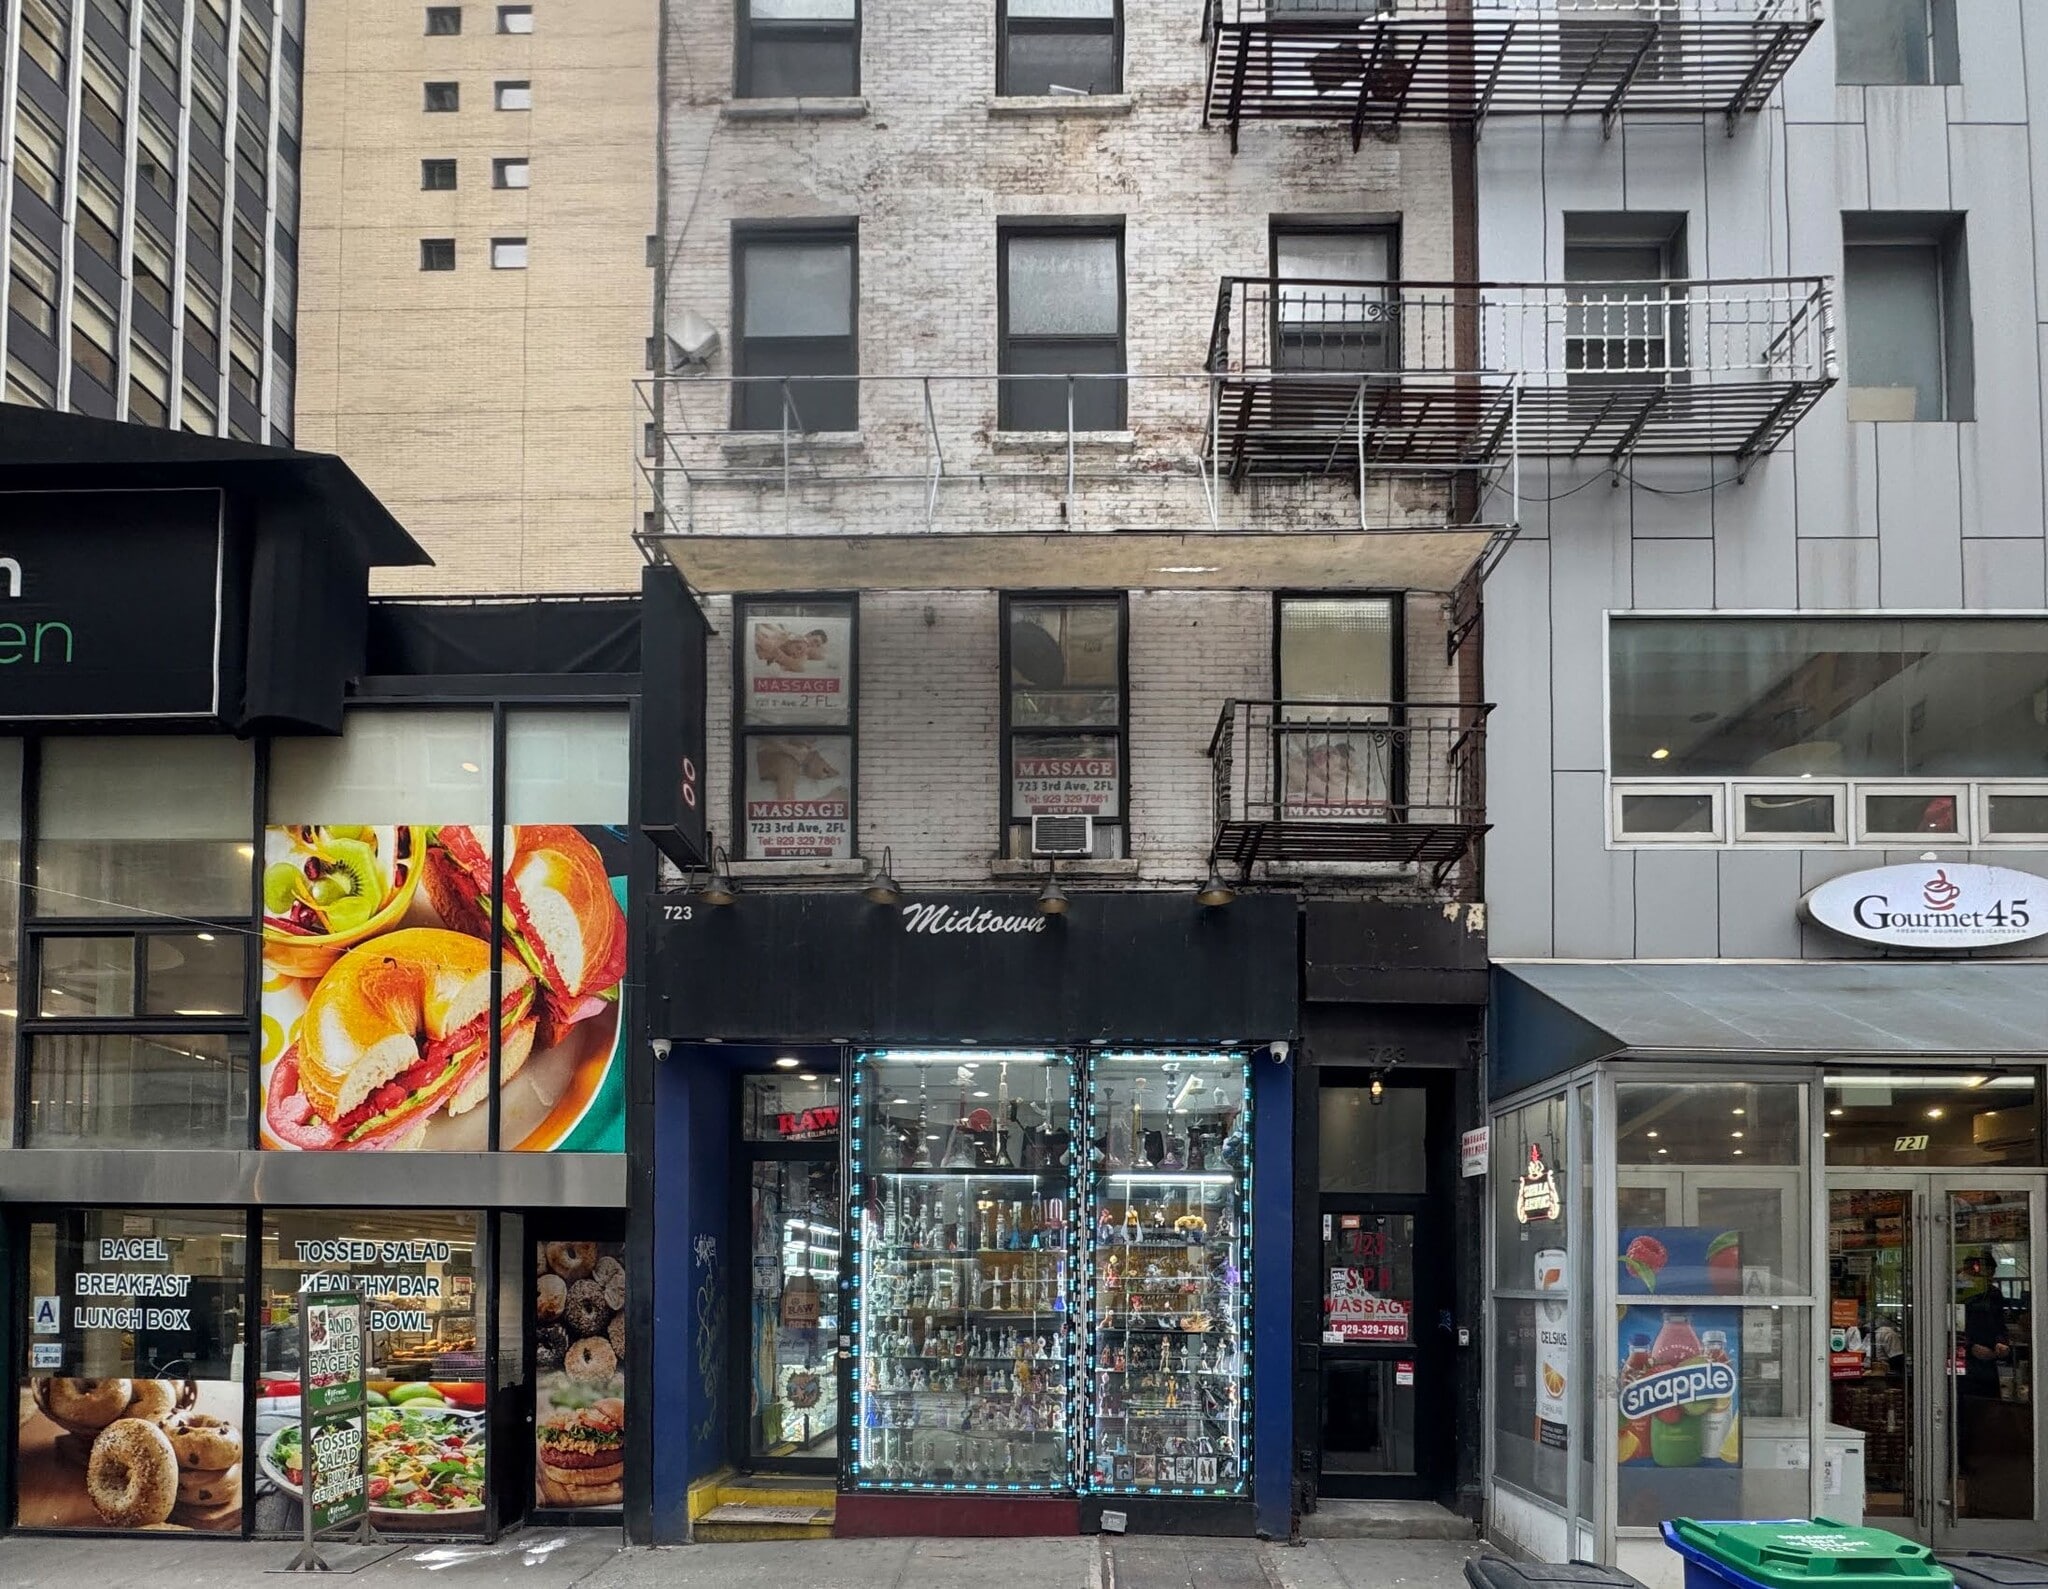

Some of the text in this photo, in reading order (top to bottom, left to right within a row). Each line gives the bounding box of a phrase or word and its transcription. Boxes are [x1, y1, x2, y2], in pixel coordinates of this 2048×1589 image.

[757, 680, 834, 692] MASSAGE
[800, 694, 809, 707] 2
[1019, 762, 1113, 776] MASSAGE
[1018, 781, 1113, 793] 723 3rd Ave, 2FL
[1024, 794, 1040, 804] Tel:
[1043, 794, 1061, 804] 929
[1064, 794, 1082, 804] 329
[752, 803, 844, 817] MASSAGE
[1288, 803, 1384, 816] MASSAGE
[751, 822, 846, 835] 723 3rd Ave, 2FL
[758, 836, 774, 845] Tel:
[776, 836, 794, 845] 929
[797, 836, 815, 845] 329
[663, 906, 692, 920] 723
[902, 903, 1046, 934] Midtown
[777, 1105, 839, 1134] RAW
[1898, 1137, 1924, 1150] 721
[100, 1238, 168, 1261] BAGEL
[296, 1240, 450, 1263] TOSSED SALAD
[75, 1273, 190, 1297] BREAKFAST
[398, 1275, 440, 1298] BAR
[1346, 1266, 1391, 1290] SPA
[38, 1301, 54, 1322] A
[788, 1303, 814, 1315] RAW
[1324, 1297, 1412, 1314] MASSAGE
[74, 1307, 191, 1331] LUNCH BOX
[328, 1317, 353, 1335] AND
[370, 1310, 432, 1332] BOWL
[1341, 1324, 1404, 1335] 929-329-7861
[1541, 1331, 1567, 1346] CELSIUS
[309, 1353, 361, 1376] BAGELS
[314, 1429, 361, 1453] TOSSED
[318, 1446, 359, 1472] SALAD
[345, 1475, 364, 1492] FREE
